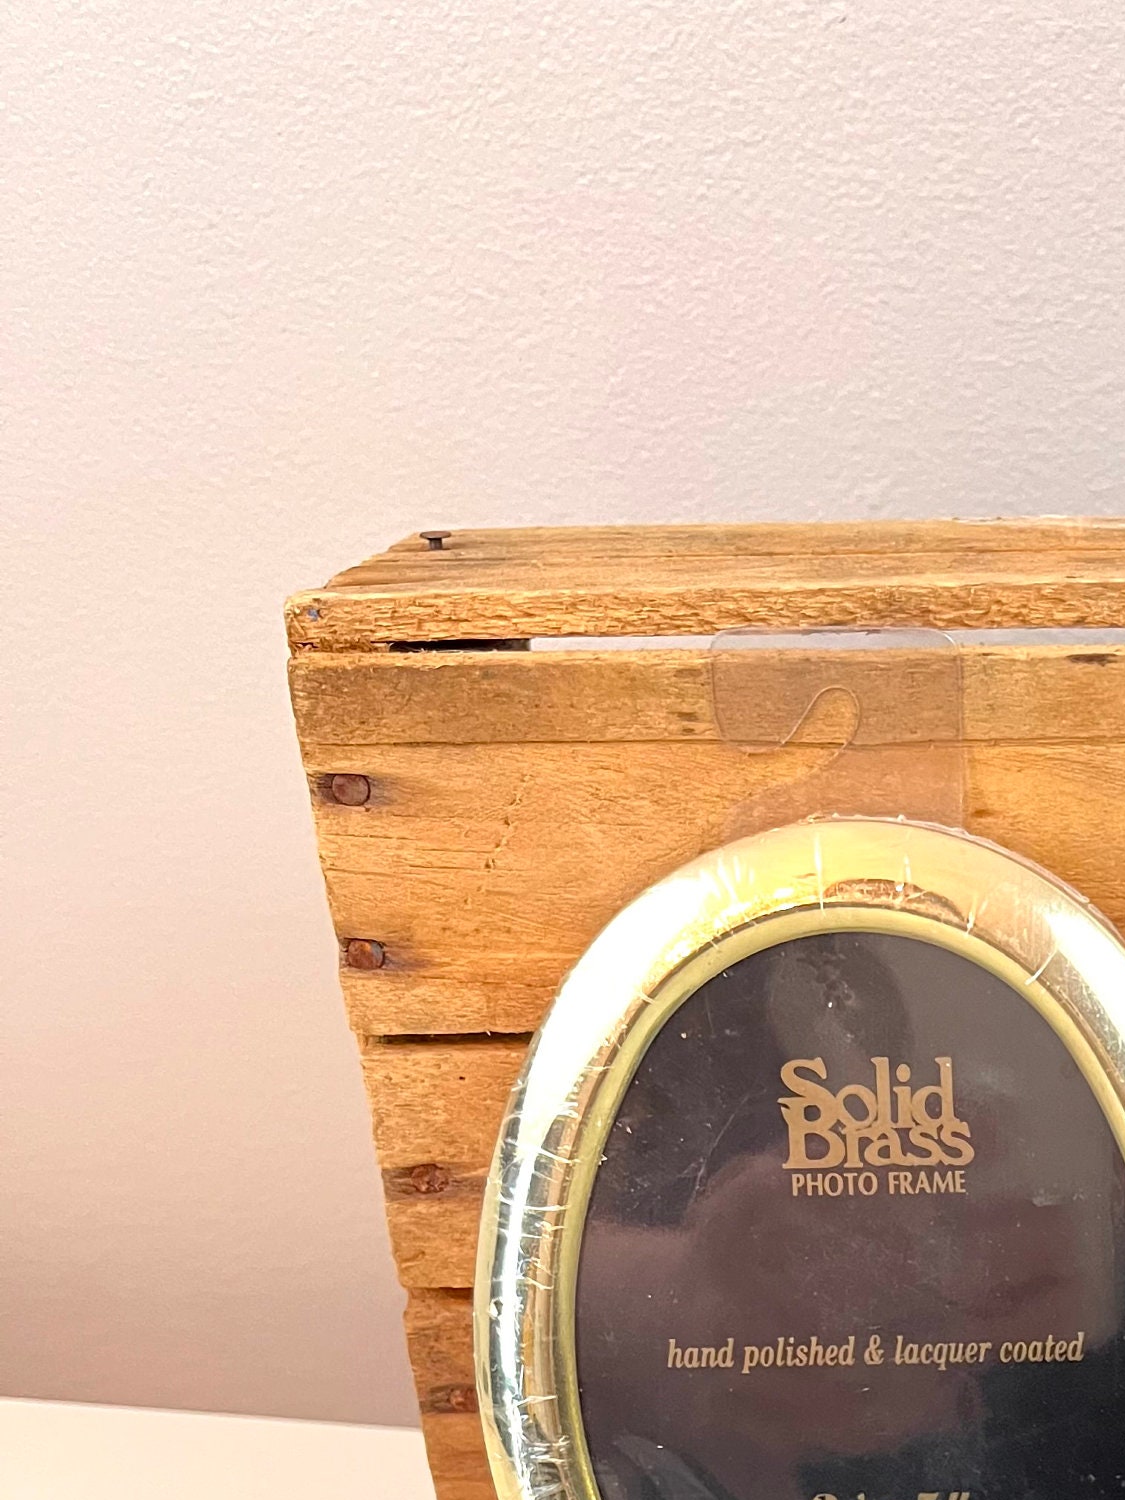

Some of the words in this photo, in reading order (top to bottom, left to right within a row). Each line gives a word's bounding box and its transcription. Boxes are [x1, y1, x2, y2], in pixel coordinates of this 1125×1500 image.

[779, 1057, 960, 1129] Solid
[777, 1097, 976, 1169] Brass
[791, 1171, 878, 1196] PHOTO
[888, 1170, 967, 1195] FRAME
[667, 1338, 734, 1369] hand
[742, 1336, 855, 1374] polished
[863, 1335, 885, 1366] &
[895, 1335, 992, 1371] lacquer
[1000, 1332, 1085, 1363] coated
